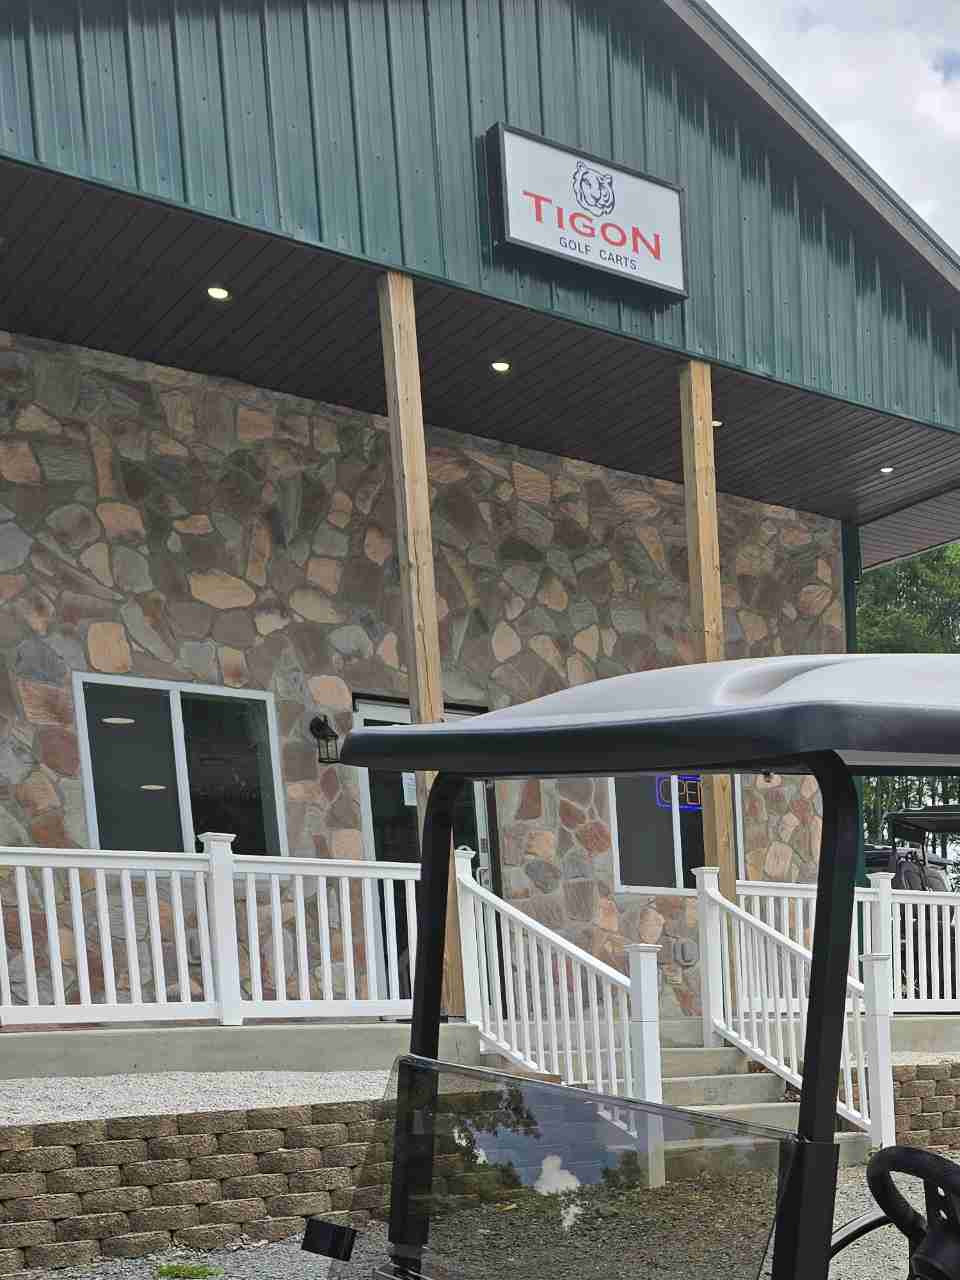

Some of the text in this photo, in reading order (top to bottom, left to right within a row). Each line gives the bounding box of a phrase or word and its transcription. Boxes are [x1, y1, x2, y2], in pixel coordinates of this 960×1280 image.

[523, 191, 661, 260] TIGON
[559, 236, 638, 271] GOLF CARTS
